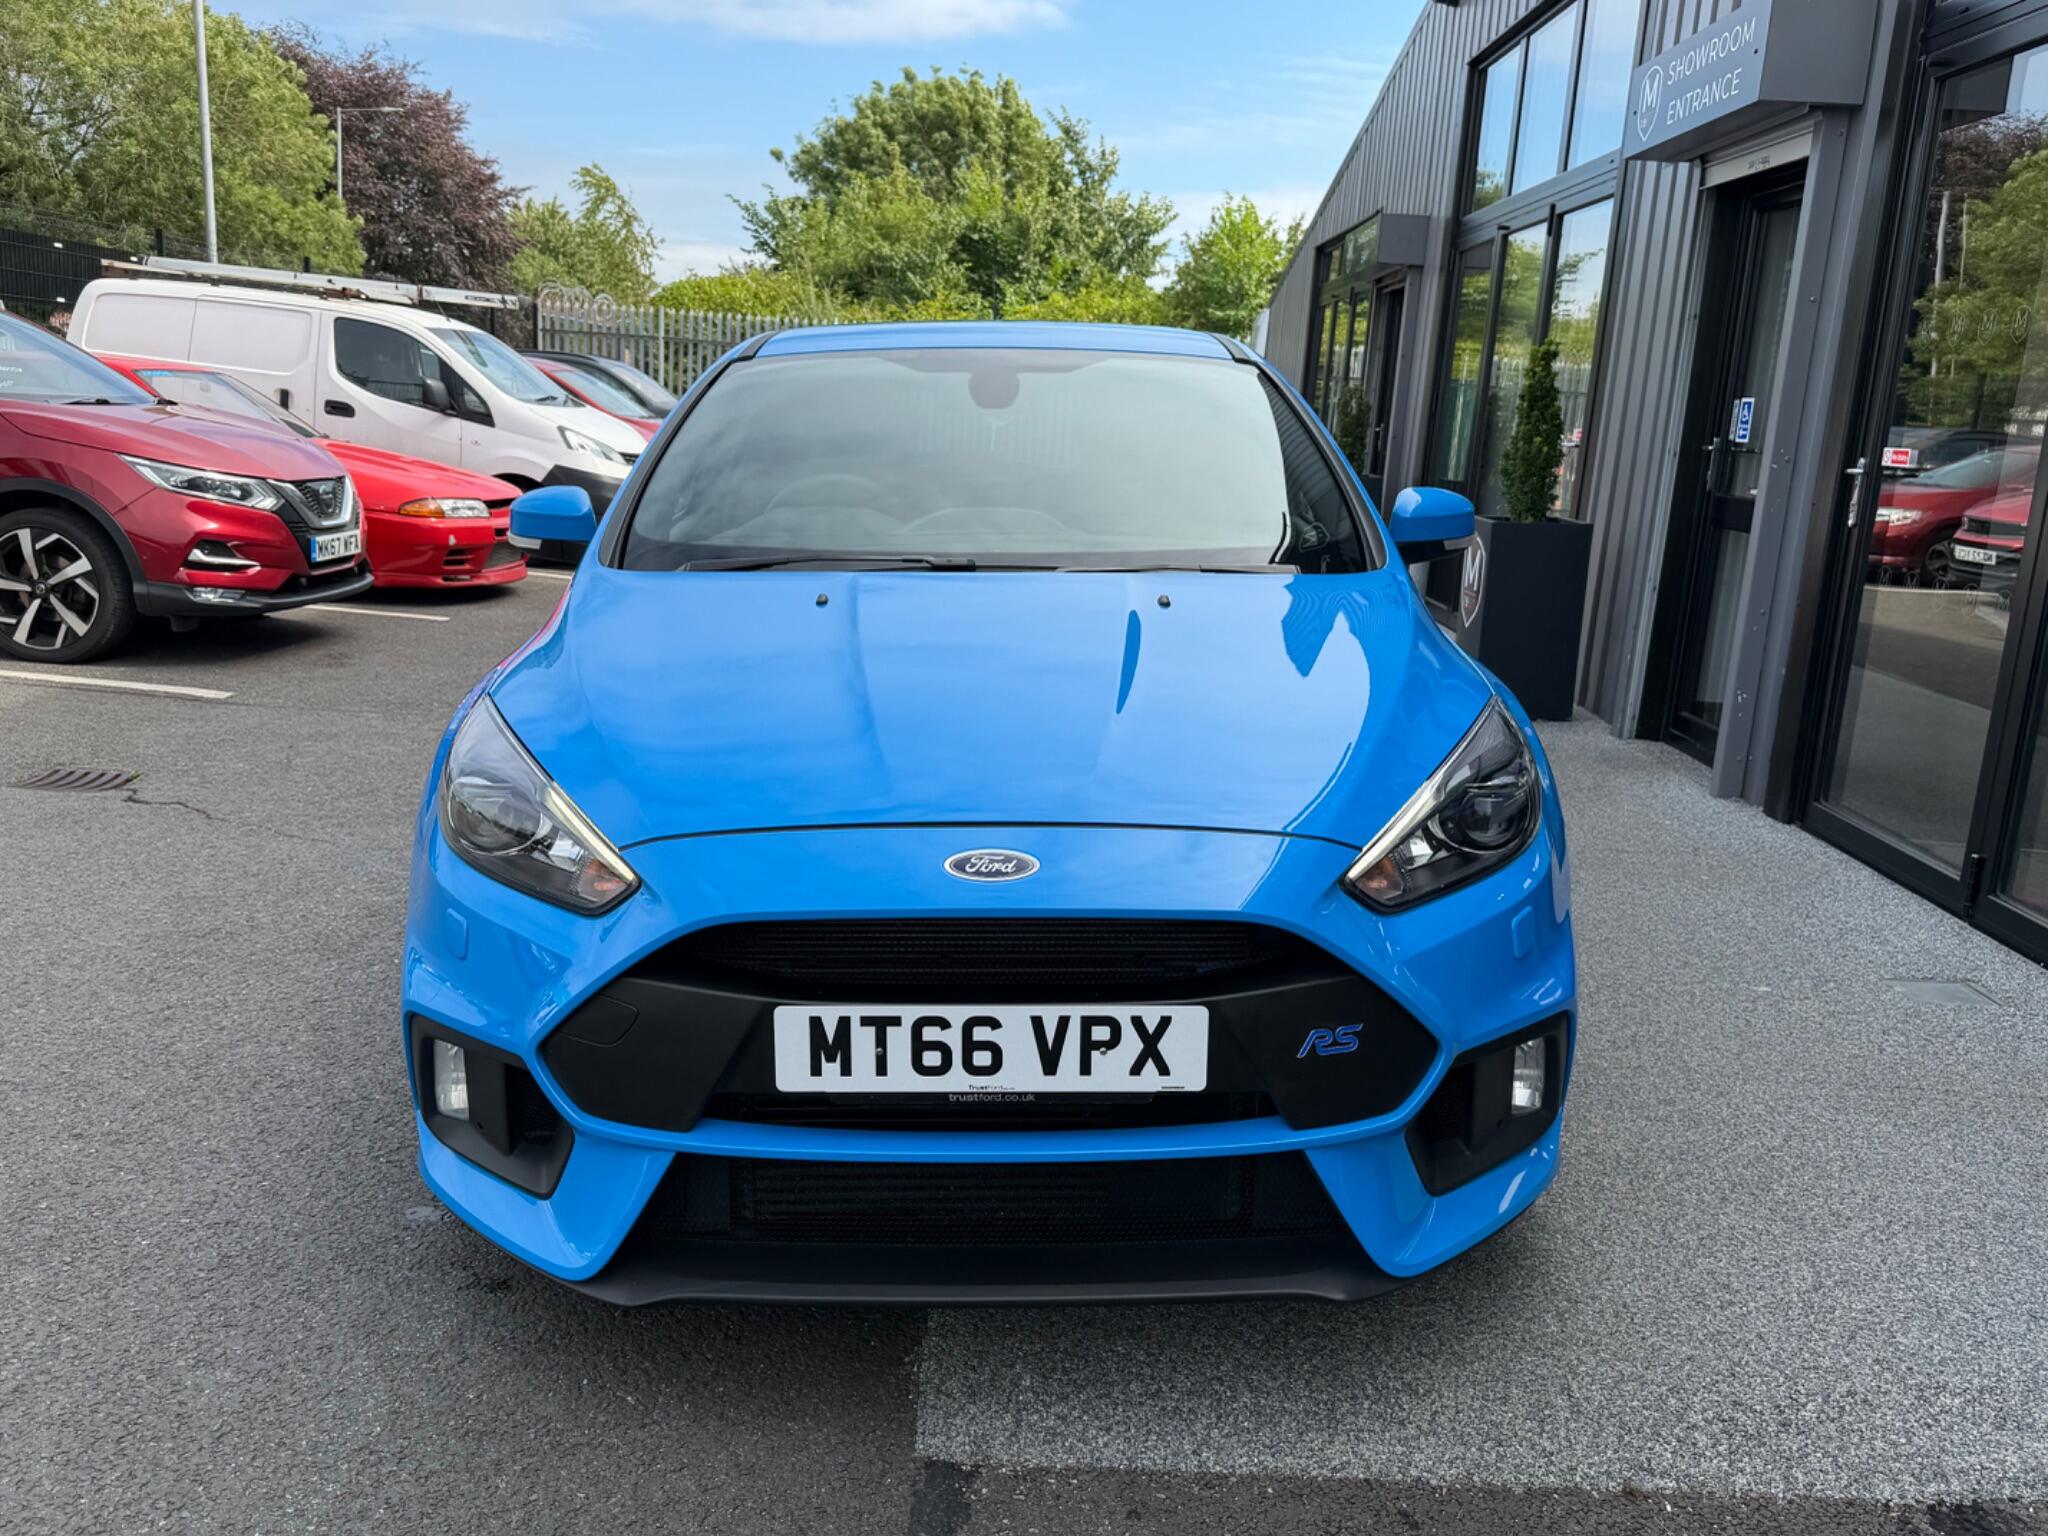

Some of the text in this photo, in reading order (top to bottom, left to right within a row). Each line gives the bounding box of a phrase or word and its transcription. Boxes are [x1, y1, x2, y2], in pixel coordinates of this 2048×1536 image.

[1667, 17, 1757, 86] SHOWROOM
[1641, 73, 1660, 113] M
[1666, 67, 1743, 126] ENTRANCE
[964, 855, 1018, 873] Ford
[808, 1014, 1174, 1078] MT66 VPX
[1296, 1022, 1364, 1058] RS
[948, 1093, 1036, 1103] trustford.co.uk
